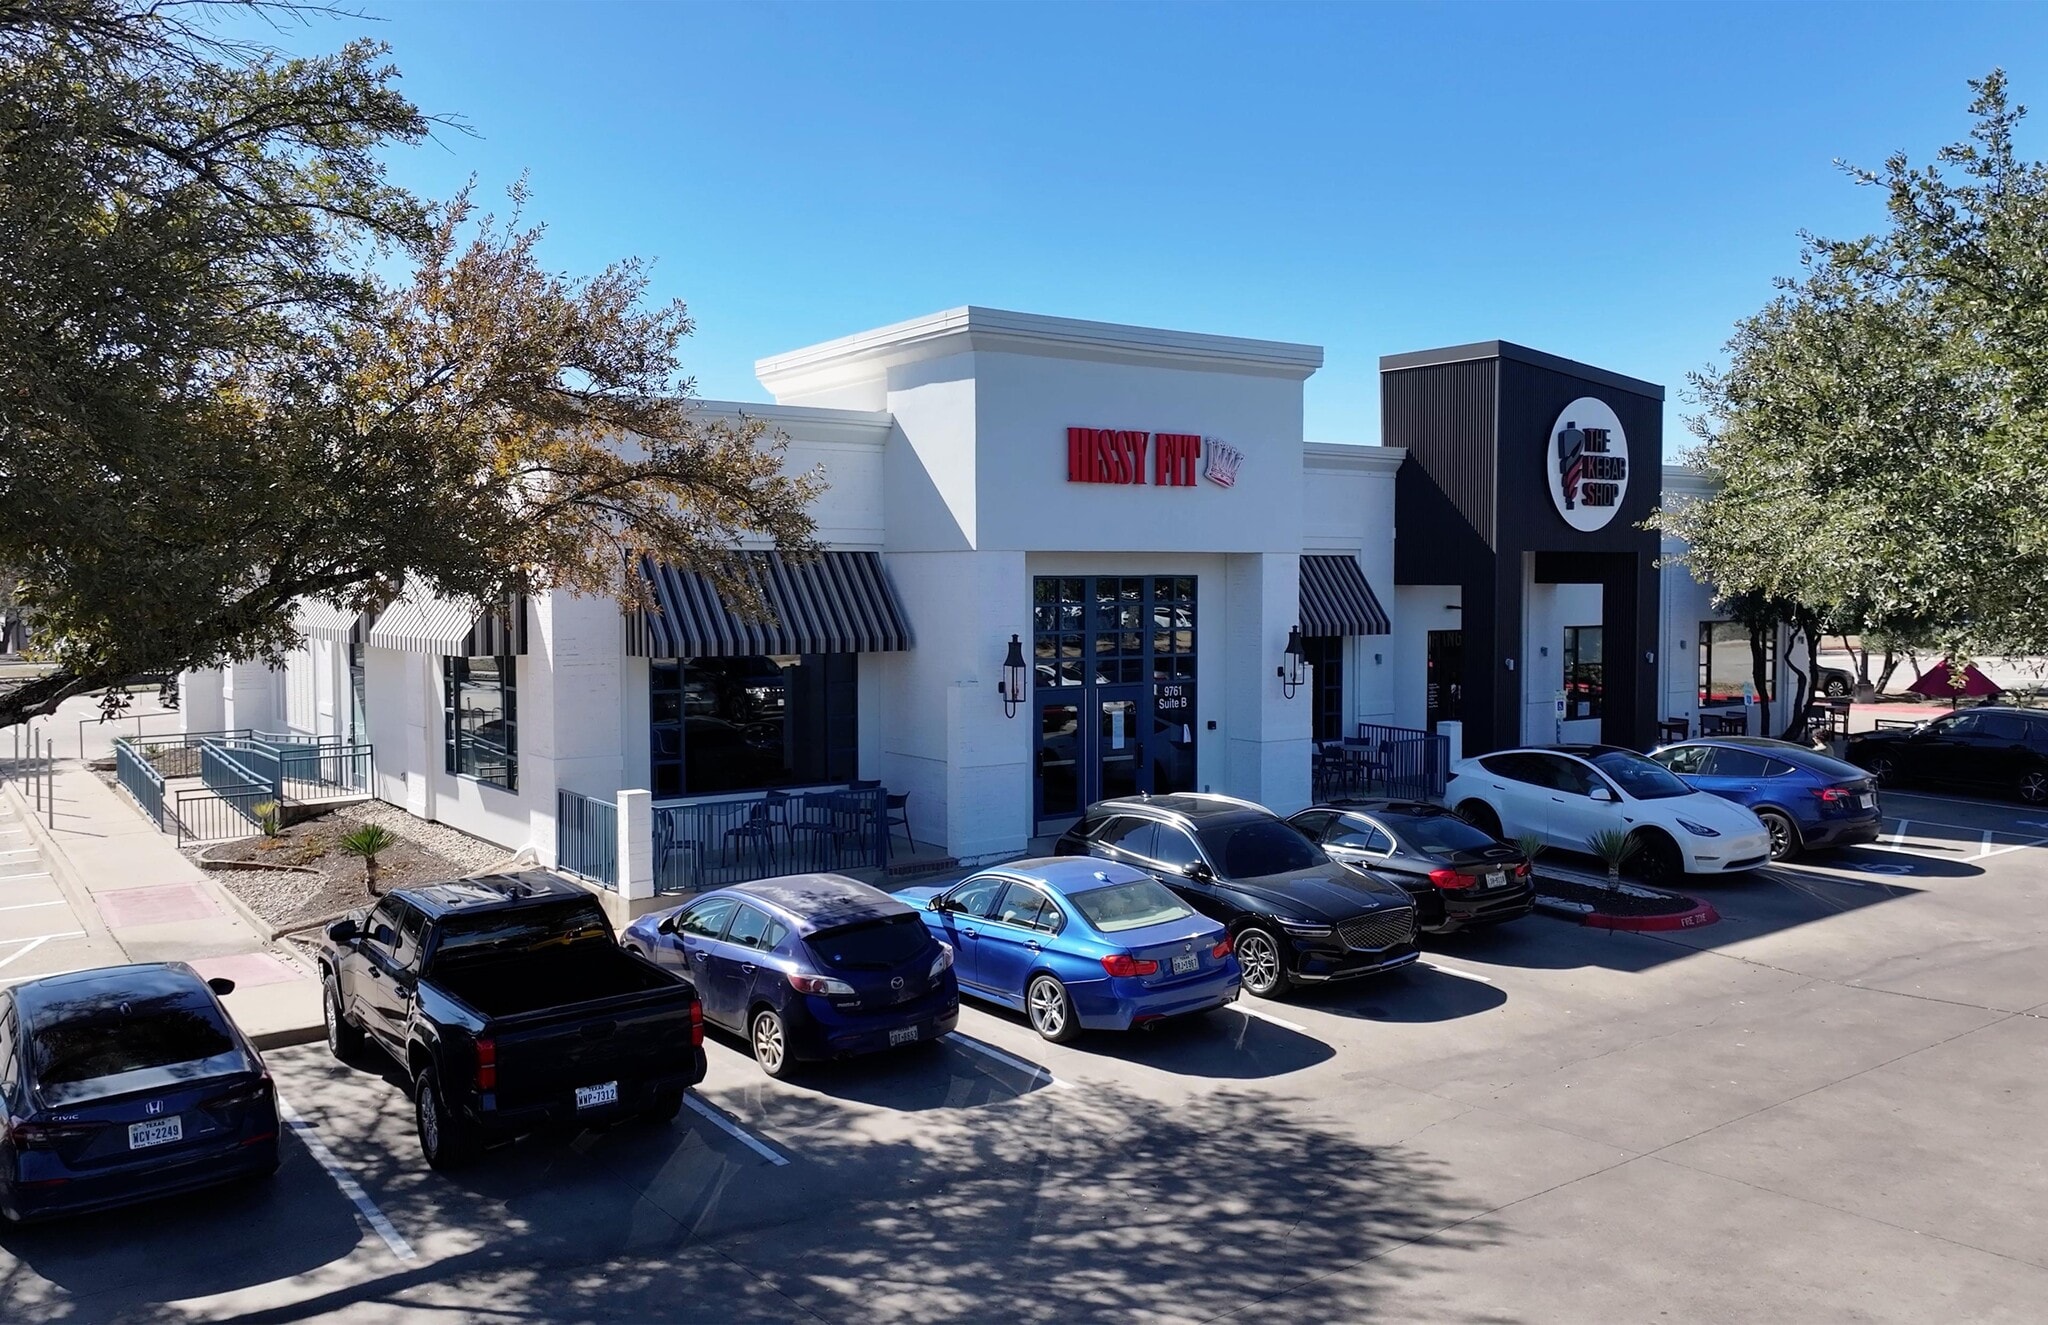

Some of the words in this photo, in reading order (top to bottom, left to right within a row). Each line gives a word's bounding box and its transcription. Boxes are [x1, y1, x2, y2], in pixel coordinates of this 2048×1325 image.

[1582, 428, 1611, 452] THE
[1067, 427, 1150, 484] HISSY
[1155, 433, 1201, 486] FIT
[1581, 455, 1626, 480] KEBAB
[1581, 483, 1619, 506] SHOP
[1164, 686, 1182, 697] 9761
[1159, 697, 1179, 709] Suite
[1180, 697, 1187, 708] B
[1681, 916, 1695, 927] FIRE
[51, 1114, 79, 1122] CIVIC
[146, 1121, 165, 1129] TEXAS
